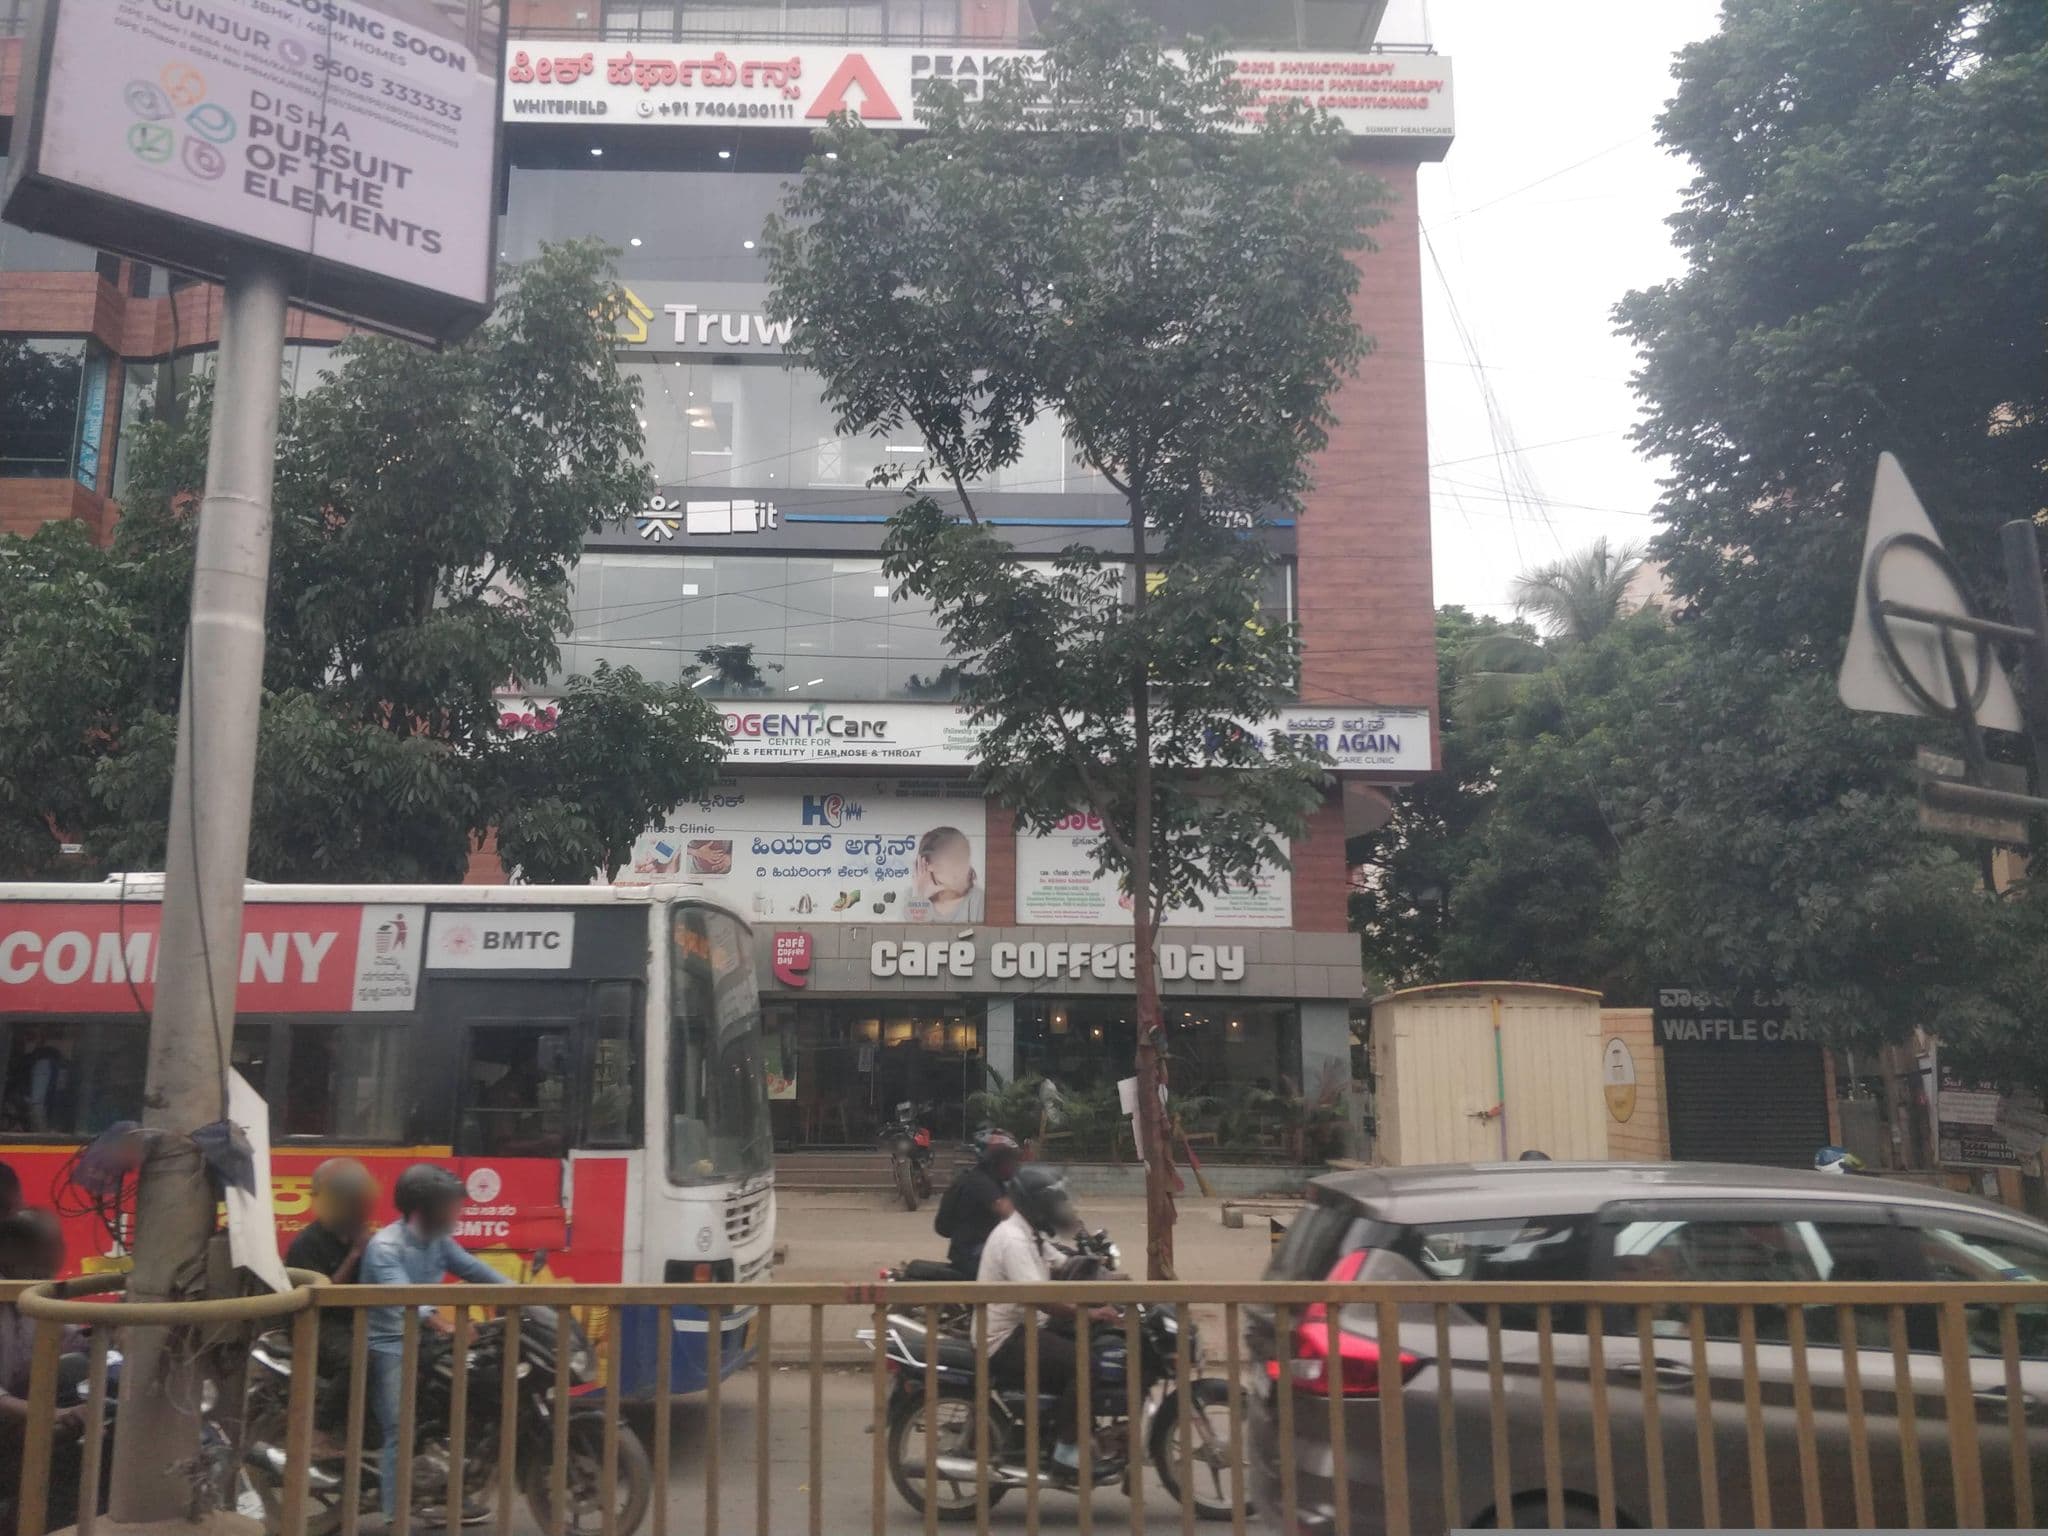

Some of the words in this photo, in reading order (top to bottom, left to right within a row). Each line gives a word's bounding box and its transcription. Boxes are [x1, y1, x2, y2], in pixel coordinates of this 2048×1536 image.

[153, 0, 271, 50] GUNJUR
[313, 53, 374, 88] 9505
[381, 78, 462, 121] 333333
[352, 38, 408, 66] HOMES
[392, 30, 466, 72] SOON
[508, 51, 594, 84] ಪೀಕ್
[1328, 79, 1444, 93] PHYSIOTHERAPY
[250, 89, 350, 141] DISHA
[513, 99, 608, 116] WHITEFIELD
[659, 102, 689, 118] +91
[695, 102, 794, 119] 7406200111
[1401, 126, 1453, 135] HEALTHCARE
[248, 114, 413, 189] PURSUIT
[246, 144, 300, 177] OF
[310, 163, 384, 209] THE
[244, 170, 443, 254] ELEMENTS
[826, 713, 889, 739] Care
[768, 737, 808, 747] CENTRE
[810, 738, 831, 747] FOR
[1337, 733, 1401, 753] AGAIN
[753, 748, 806, 757] FERTILITY
[882, 749, 922, 759] THROAT
[1337, 756, 1363, 765] CARE
[1364, 756, 1395, 765] CLINIC
[680, 823, 715, 834] Clinic
[751, 834, 832, 855] ಹಿಯರ್
[772, 866, 832, 878] ಹಿಯರಿಂಗ್
[482, 930, 561, 951] BMTC
[0, 931, 339, 984] COMNY
[1662, 1019, 1758, 1041] WAFFLE
